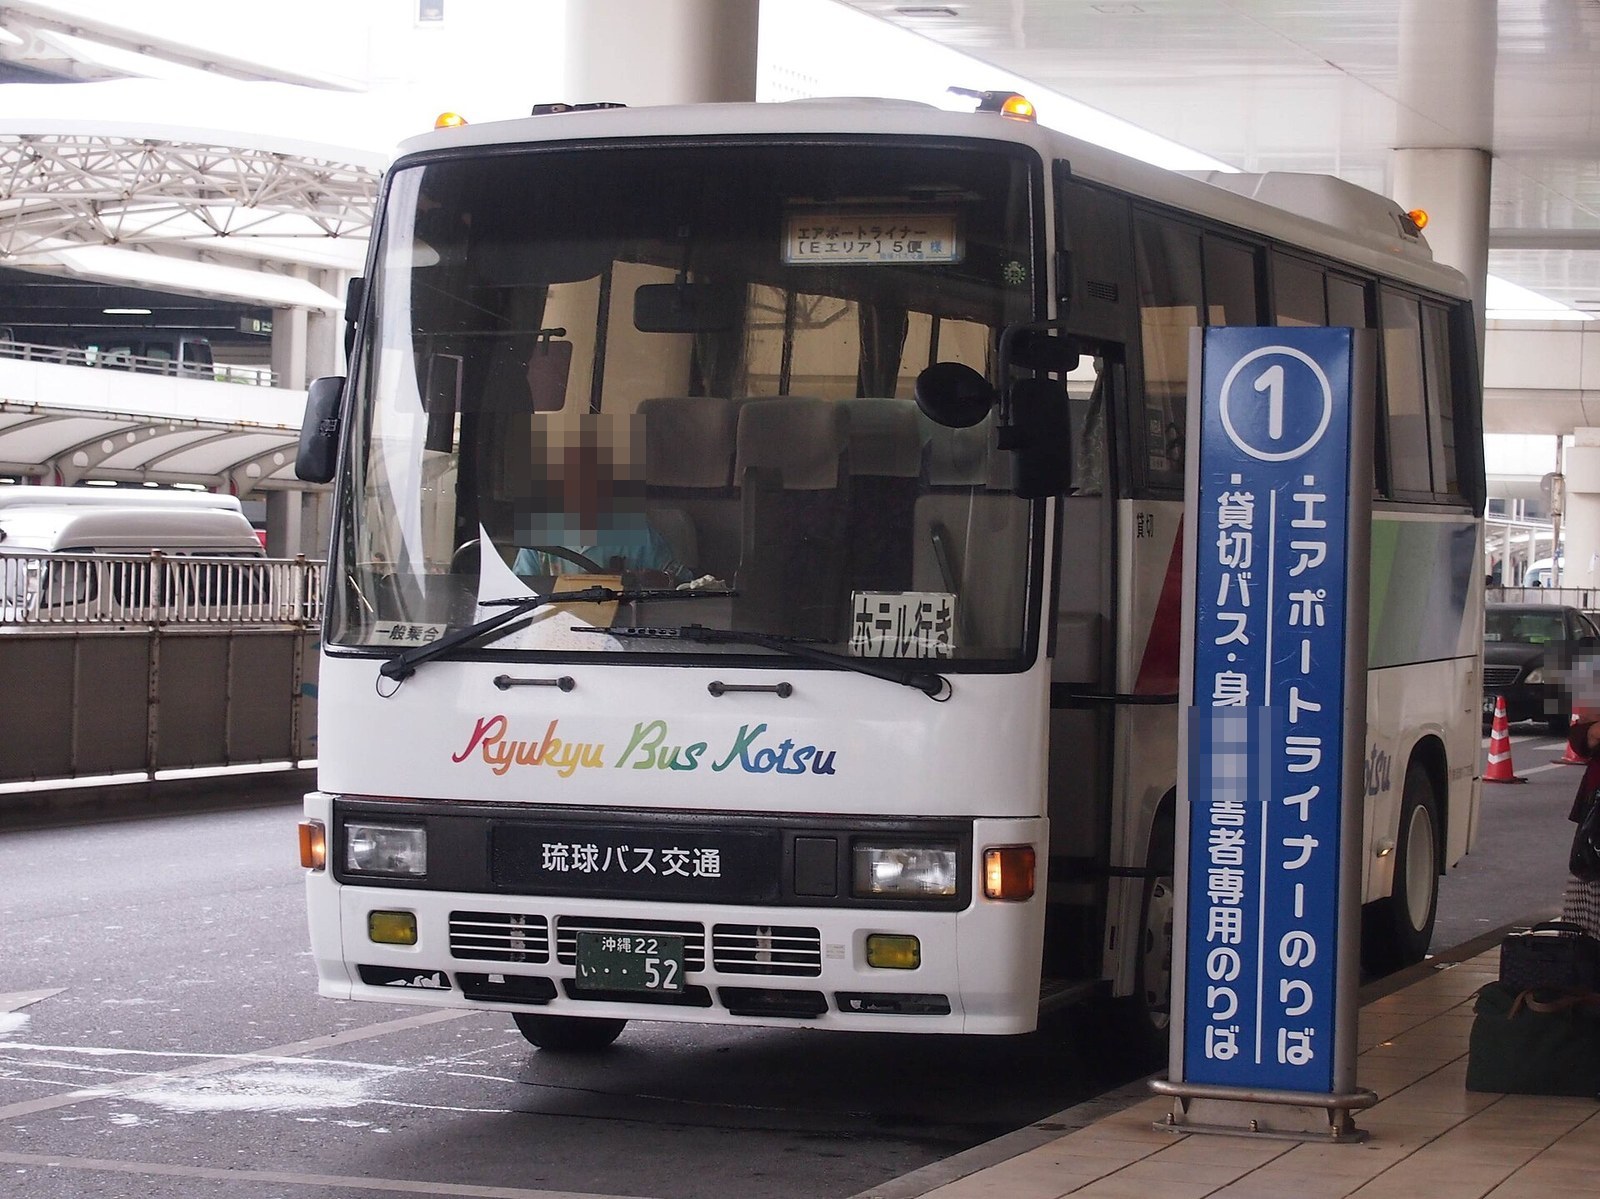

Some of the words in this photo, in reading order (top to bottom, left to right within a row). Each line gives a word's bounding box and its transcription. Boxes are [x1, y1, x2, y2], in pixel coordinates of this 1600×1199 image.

[798, 226, 927, 240] エアポートライナー
[1136, 512, 1154, 538] 貸切
[375, 624, 439, 642] 一般乗合
[855, 597, 952, 659] ホテル行き
[451, 714, 605, 778] Ryukyu
[614, 719, 708, 772] Bus
[711, 722, 837, 776] Kotsu
[1204, 491, 1254, 1061] 貸切バス・身害者専用のりば
[541, 842, 723, 878] 琉球バス交通
[601, 936, 632, 953] 沖縄
[634, 938, 658, 955] 22
